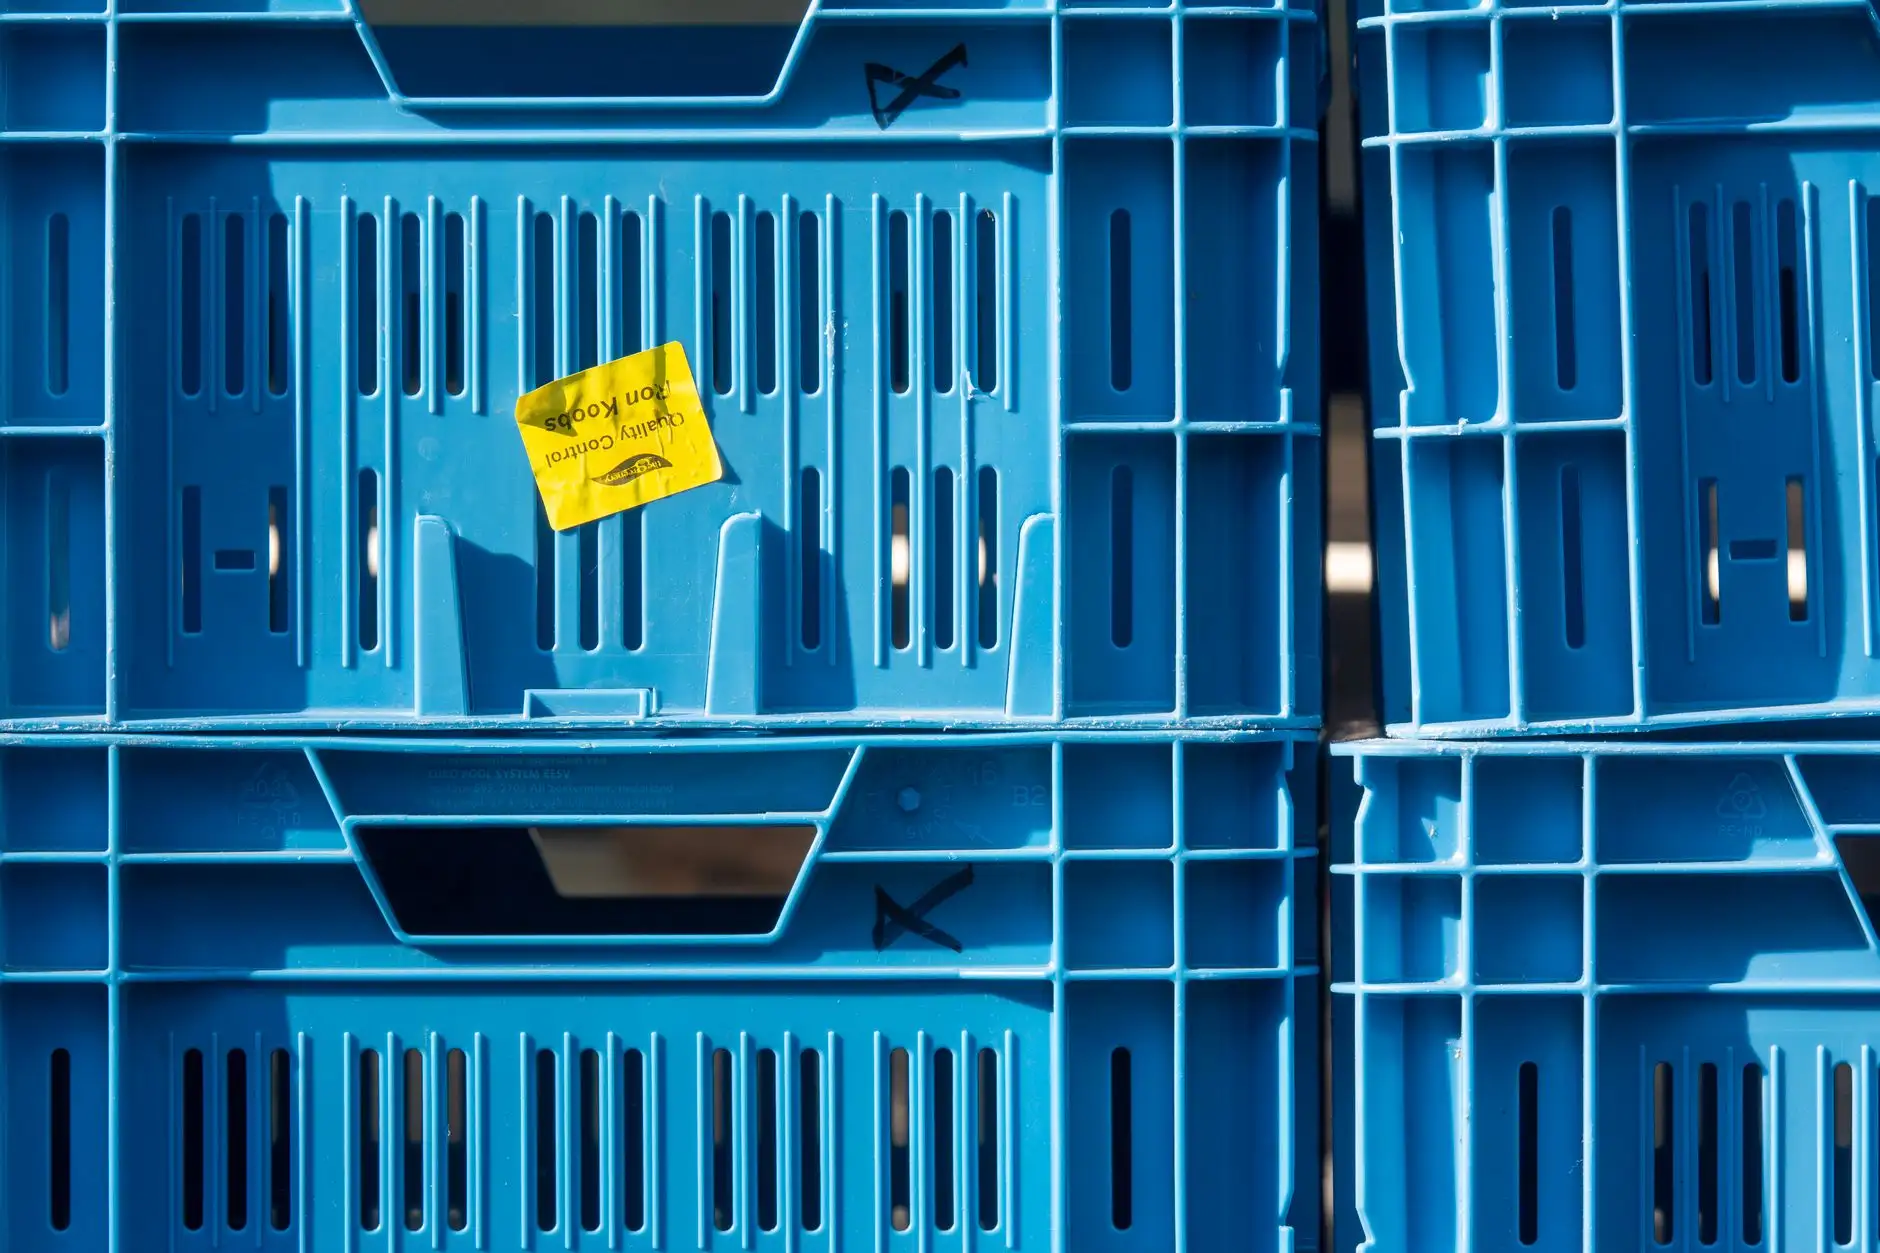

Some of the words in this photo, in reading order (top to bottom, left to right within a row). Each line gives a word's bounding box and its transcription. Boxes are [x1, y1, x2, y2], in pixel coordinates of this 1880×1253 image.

[626, 380, 670, 406] Ron
[544, 397, 618, 431] Koobs
[620, 411, 685, 441] Quality
[545, 434, 614, 468] Control
